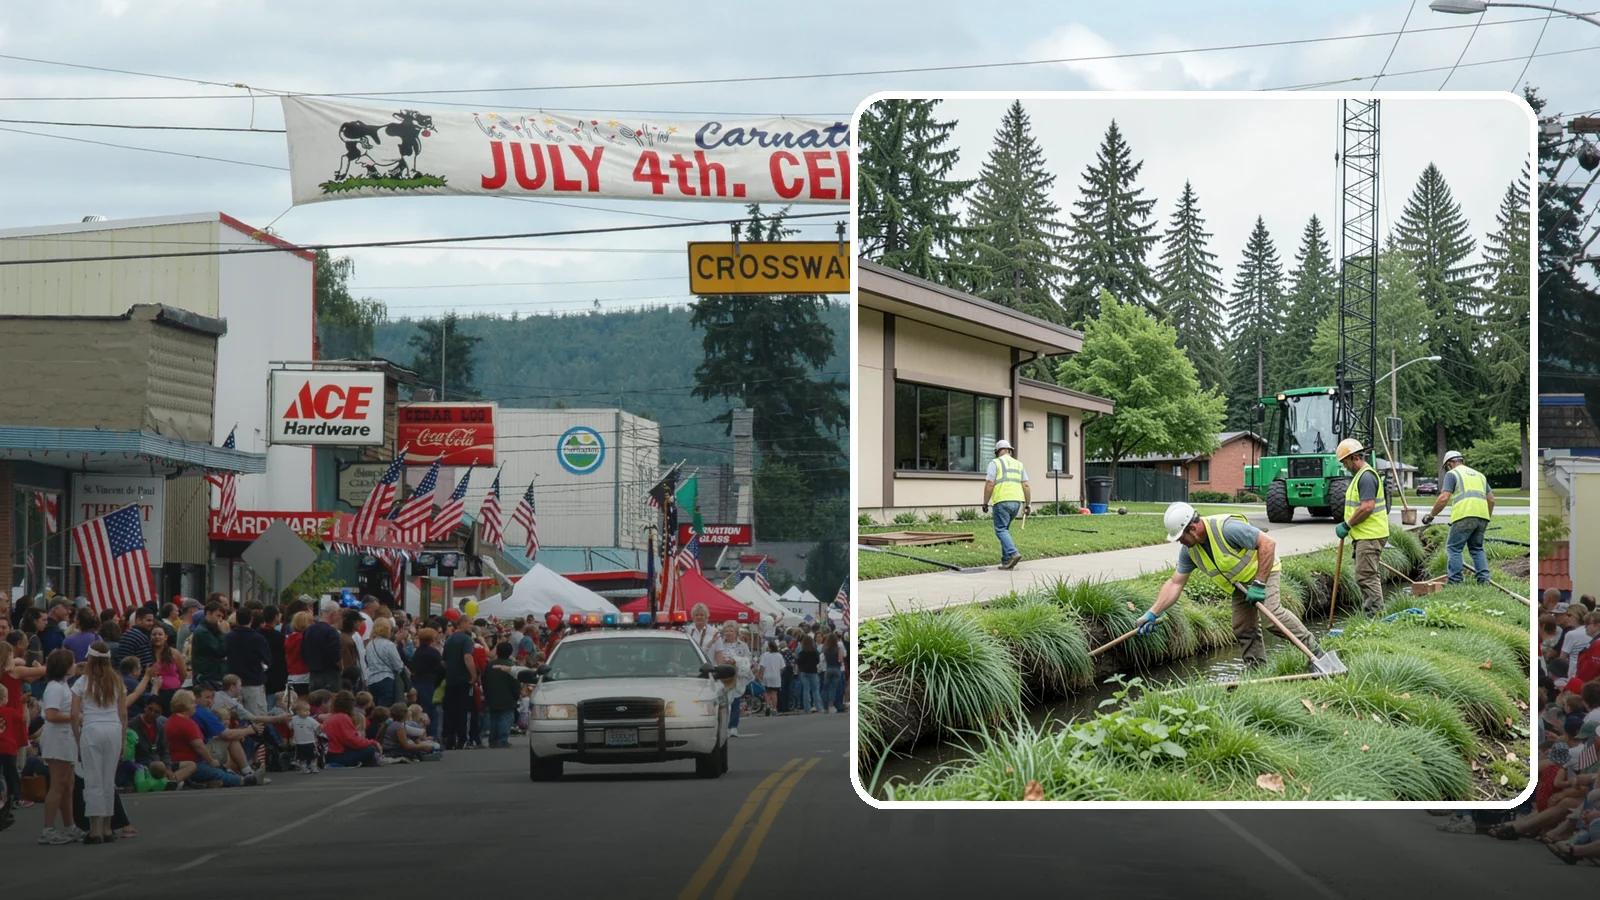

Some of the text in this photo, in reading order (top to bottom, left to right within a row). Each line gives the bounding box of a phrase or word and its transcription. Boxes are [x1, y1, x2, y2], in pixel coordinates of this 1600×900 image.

[481, 141, 605, 193] JULY
[632, 149, 746, 198] 4th.
[697, 254, 850, 280] CROSSWA
[282, 380, 374, 420] ACE
[405, 409, 452, 422] CEDAR
[283, 421, 371, 436] Hardware
[416, 428, 477, 447] Coca-Cola
[353, 466, 385, 480] Simpl
[95, 485, 124, 495] Vincent
[126, 486, 136, 495] de
[137, 486, 155, 495] Paul
[81, 503, 154, 522] THT
[212, 516, 331, 535] HARDARE
[688, 526, 741, 535] CRNATION
[699, 535, 730, 543] GLASS
